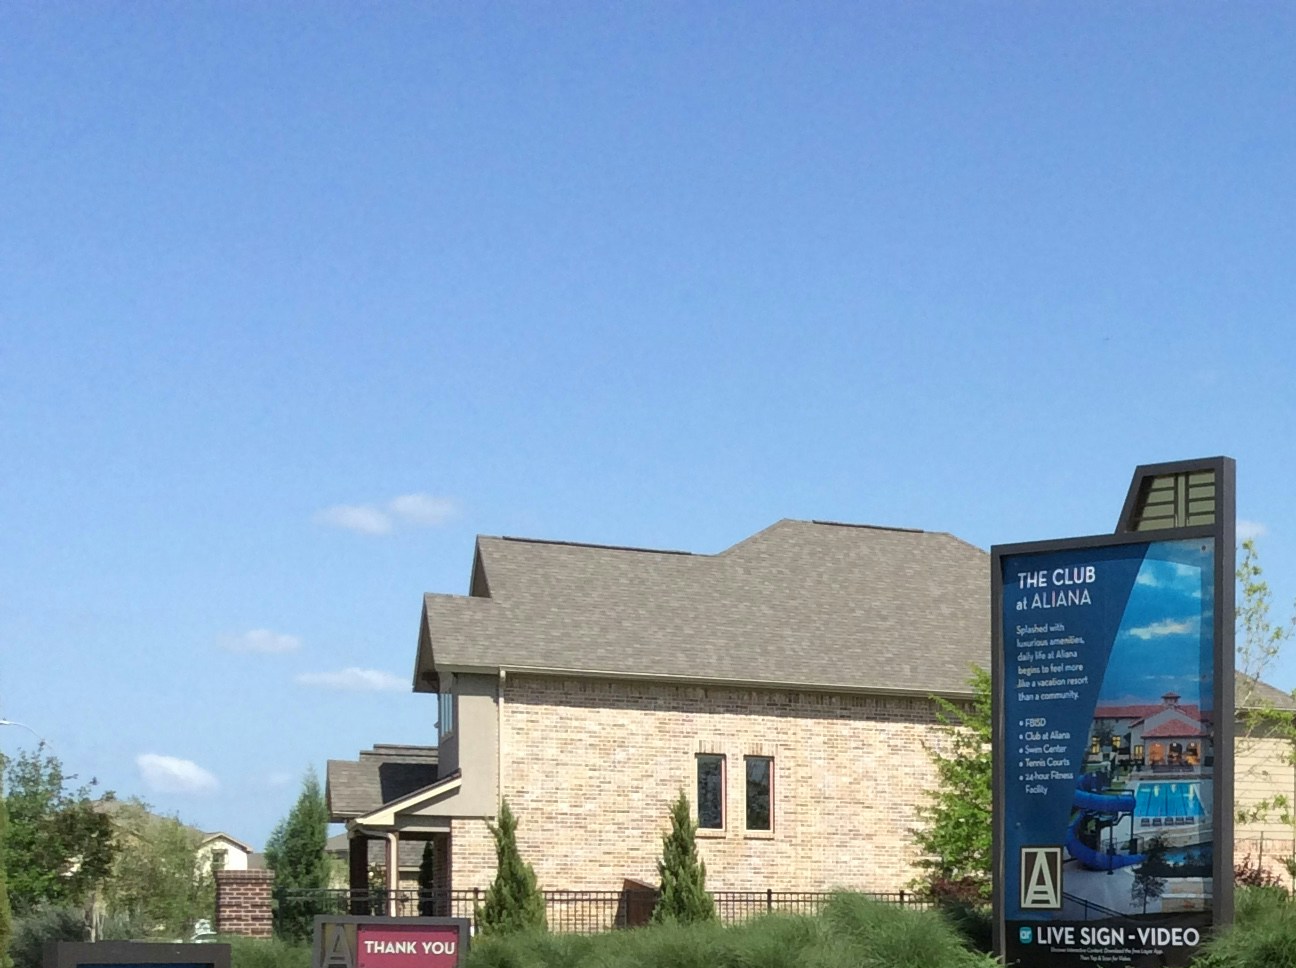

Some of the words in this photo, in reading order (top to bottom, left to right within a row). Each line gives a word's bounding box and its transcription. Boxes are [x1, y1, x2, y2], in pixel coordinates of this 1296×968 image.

[1017, 570, 1047, 589] THE
[1052, 566, 1096, 586] CLUB
[1016, 596, 1027, 611] at
[1031, 588, 1092, 609] ALIANA
[1016, 623, 1048, 636] Splashed
[1049, 623, 1065, 632] with
[1016, 638, 1049, 648] luxurious
[1017, 651, 1034, 662] daily
[1035, 650, 1046, 660] life
[1047, 650, 1055, 659] at
[1055, 649, 1078, 659] Aliana
[1018, 665, 1040, 677] begins
[1041, 665, 1050, 674] to
[1050, 663, 1064, 673] feel
[1065, 663, 1084, 671] more
[1018, 678, 1031, 688] like
[1037, 677, 1066, 687] vacation
[1066, 676, 1088, 685] resort
[1018, 691, 1034, 701] than
[1040, 690, 1079, 701] community.
[1025, 731, 1041, 741] Club
[1042, 731, 1049, 740] at
[1050, 730, 1070, 740] Aliana
[1025, 744, 1042, 754] Swim
[1043, 743, 1067, 753] Center
[1025, 758, 1046, 767] Tennis
[1046, 757, 1070, 767] Courts
[1050, 770, 1073, 780] Fitness
[1025, 784, 1048, 795] Facility
[1037, 926, 1075, 945] LIVE
[1080, 927, 1124, 946] SIGN
[1137, 928, 1200, 947] VIDEO
[364, 941, 417, 954] THANK
[422, 941, 455, 955] YOU
